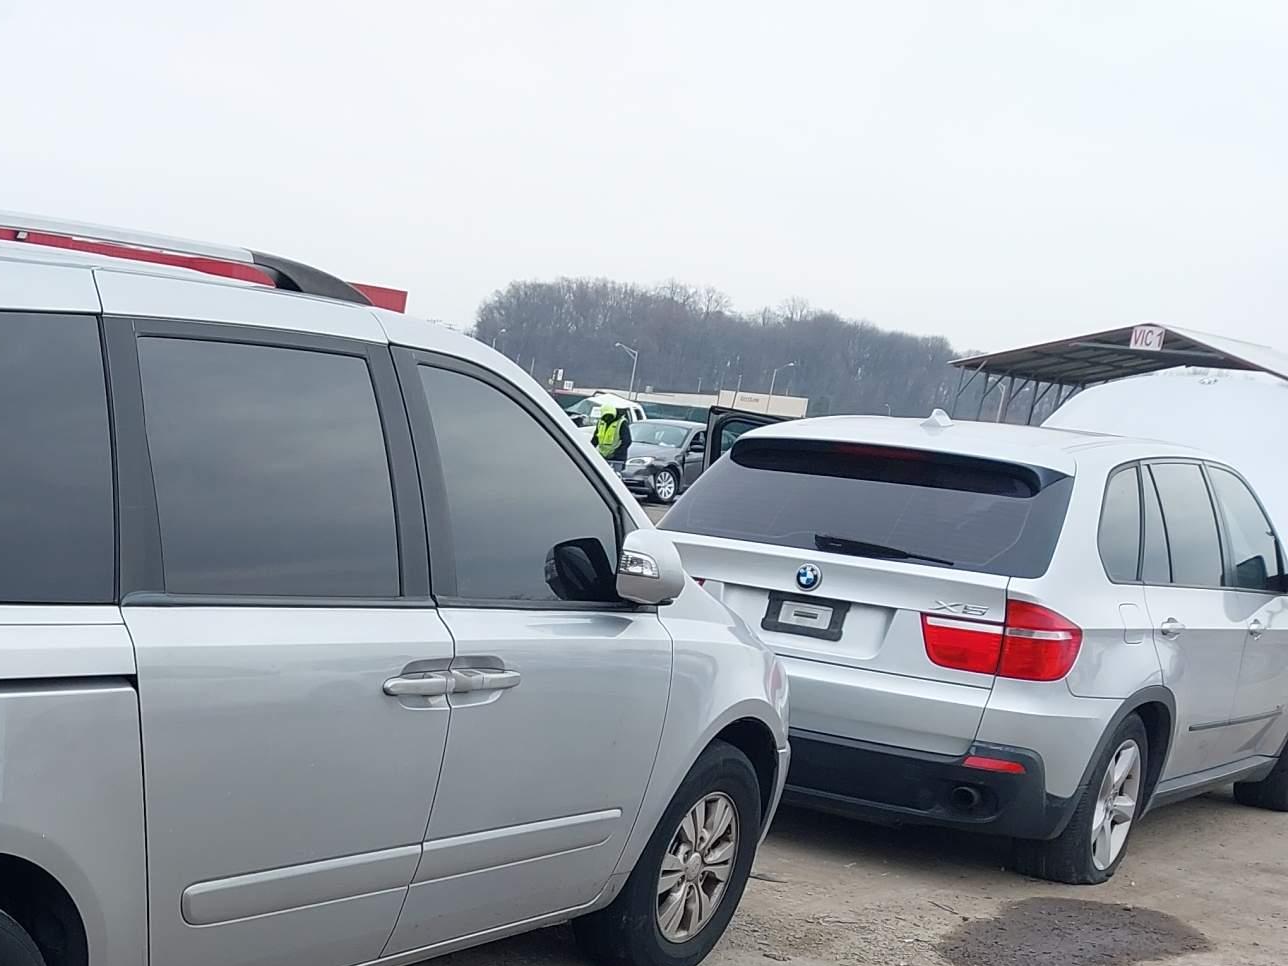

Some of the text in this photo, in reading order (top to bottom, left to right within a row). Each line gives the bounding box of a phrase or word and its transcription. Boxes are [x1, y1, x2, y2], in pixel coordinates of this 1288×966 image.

[1134, 329, 1164, 348] VIC 1
[928, 600, 990, 616] X5
